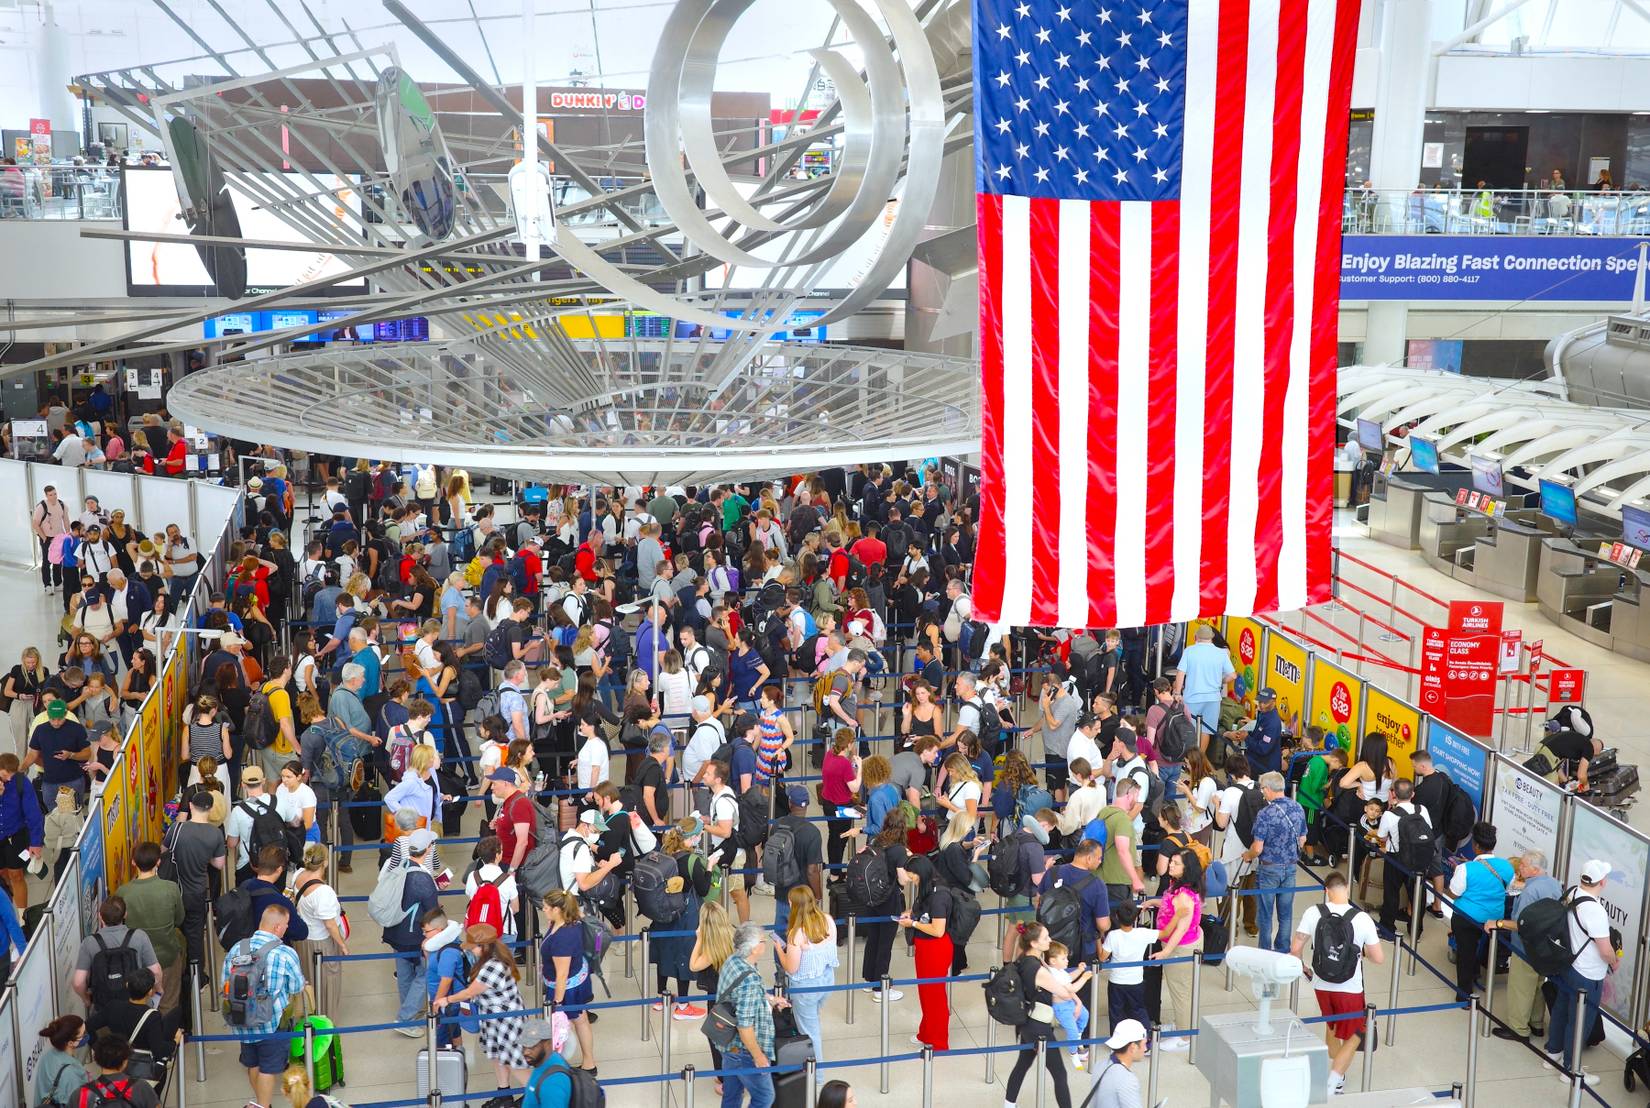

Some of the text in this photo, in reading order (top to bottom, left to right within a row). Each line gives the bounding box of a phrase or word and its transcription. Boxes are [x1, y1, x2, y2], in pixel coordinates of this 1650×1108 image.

[551, 93, 616, 109] DUNKIN'
[1342, 252, 1650, 274] Enjoy Blazing Fast Connection Spe
[1380, 275, 1415, 284] Support:
[1418, 275, 1440, 284] (800)
[1442, 275, 1480, 283] 880-4117
[84, 375, 90, 384] 3
[36, 424, 44, 434] 4
[1332, 696, 1348, 716] $32
[1377, 712, 1400, 733] enjoy
[1522, 782, 1543, 800] BEAUTY
[1600, 896, 1628, 926] EAUTY
